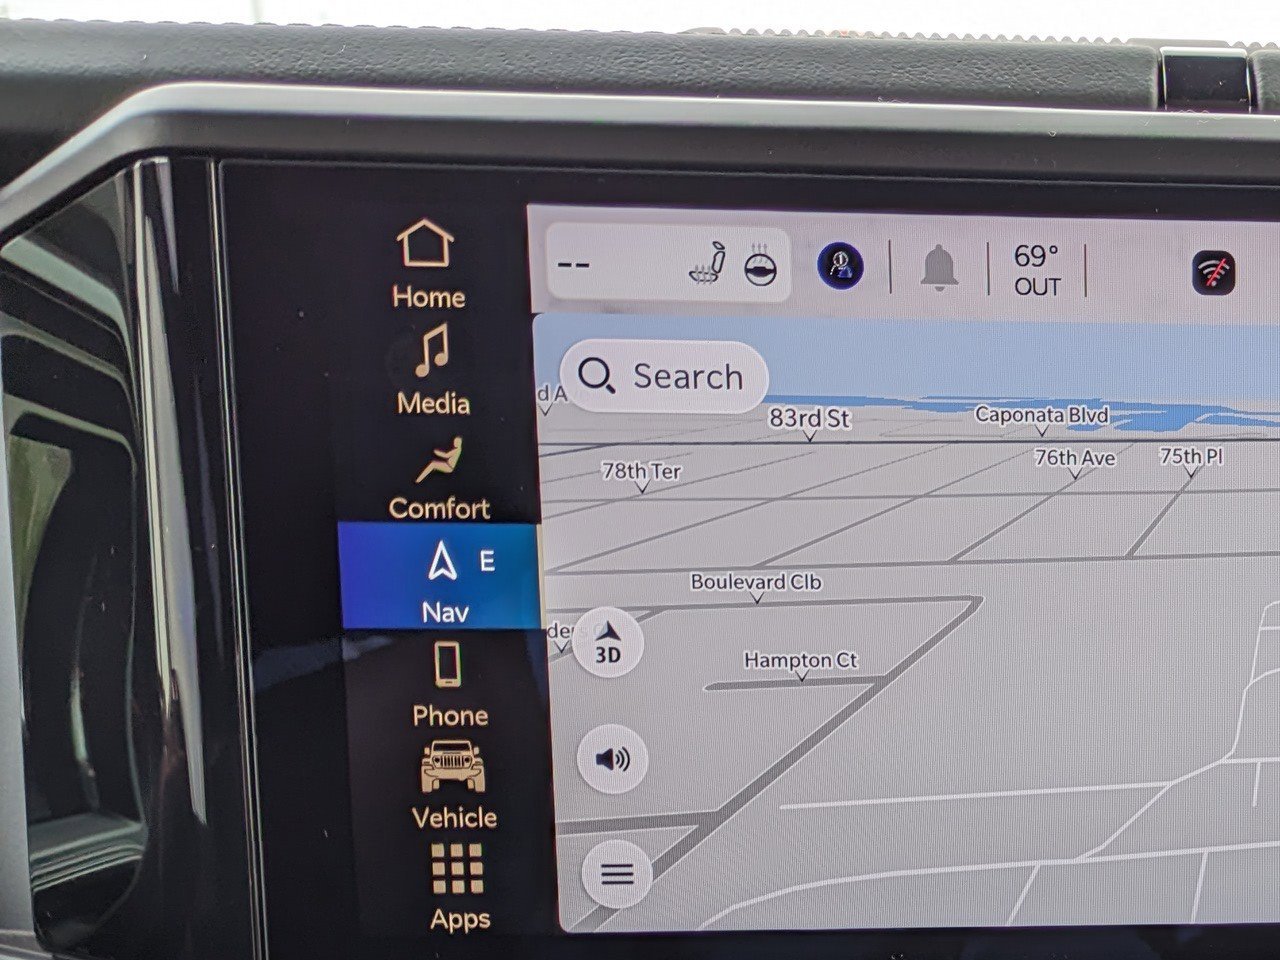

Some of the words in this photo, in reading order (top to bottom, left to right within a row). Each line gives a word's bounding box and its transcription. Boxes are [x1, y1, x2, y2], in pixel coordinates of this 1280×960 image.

[1014, 244, 1060, 269] 69°
[393, 286, 466, 309] Home
[1014, 278, 1062, 298] OUT
[633, 362, 743, 390] Search
[397, 391, 471, 415] Media
[769, 408, 822, 429] 83rd
[827, 408, 852, 429] St
[975, 406, 1064, 427] Caponata
[1068, 406, 1109, 425] Blvd
[1035, 449, 1076, 467] 76th
[1080, 449, 1116, 467] Ave
[1161, 447, 1202, 466] 75th
[1205, 447, 1223, 466] Pl
[602, 463, 646, 481] 78th
[650, 463, 682, 481] Ter
[389, 497, 491, 520] Comfort
[480, 549, 496, 572] E
[691, 573, 787, 591] Boulevard
[791, 573, 822, 591] Clb
[422, 601, 470, 624] Nav
[595, 646, 621, 663] 3D
[744, 651, 834, 673] Hampton
[837, 651, 858, 670] Ct
[413, 704, 489, 727] Phone
[412, 806, 498, 830] Vehicle
[430, 909, 491, 934] Apps
